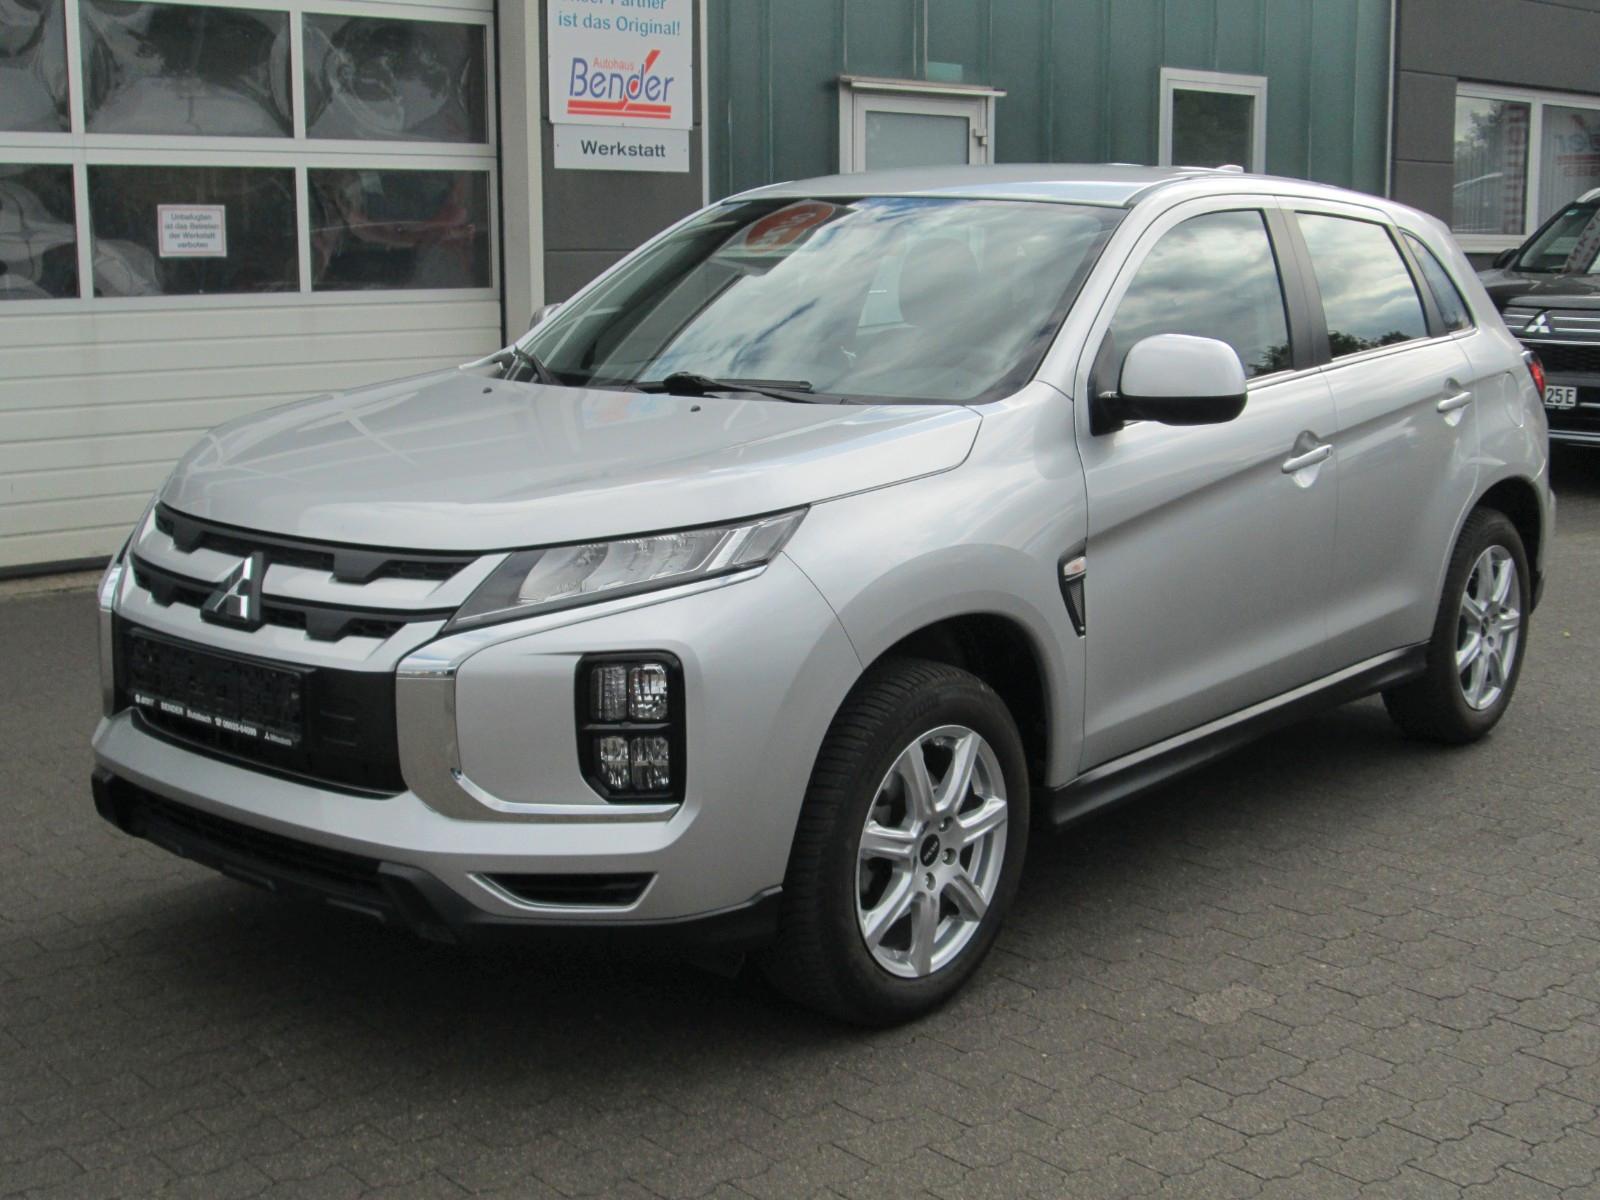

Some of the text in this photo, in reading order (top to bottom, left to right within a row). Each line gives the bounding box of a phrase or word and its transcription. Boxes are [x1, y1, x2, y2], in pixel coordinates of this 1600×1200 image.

[558, 11, 680, 37] ist das Original!
[593, 57, 634, 71] Autohaus
[569, 54, 674, 102] Bender
[581, 139, 666, 158] Werkstatt
[182, 231, 215, 240] Werkstatt
